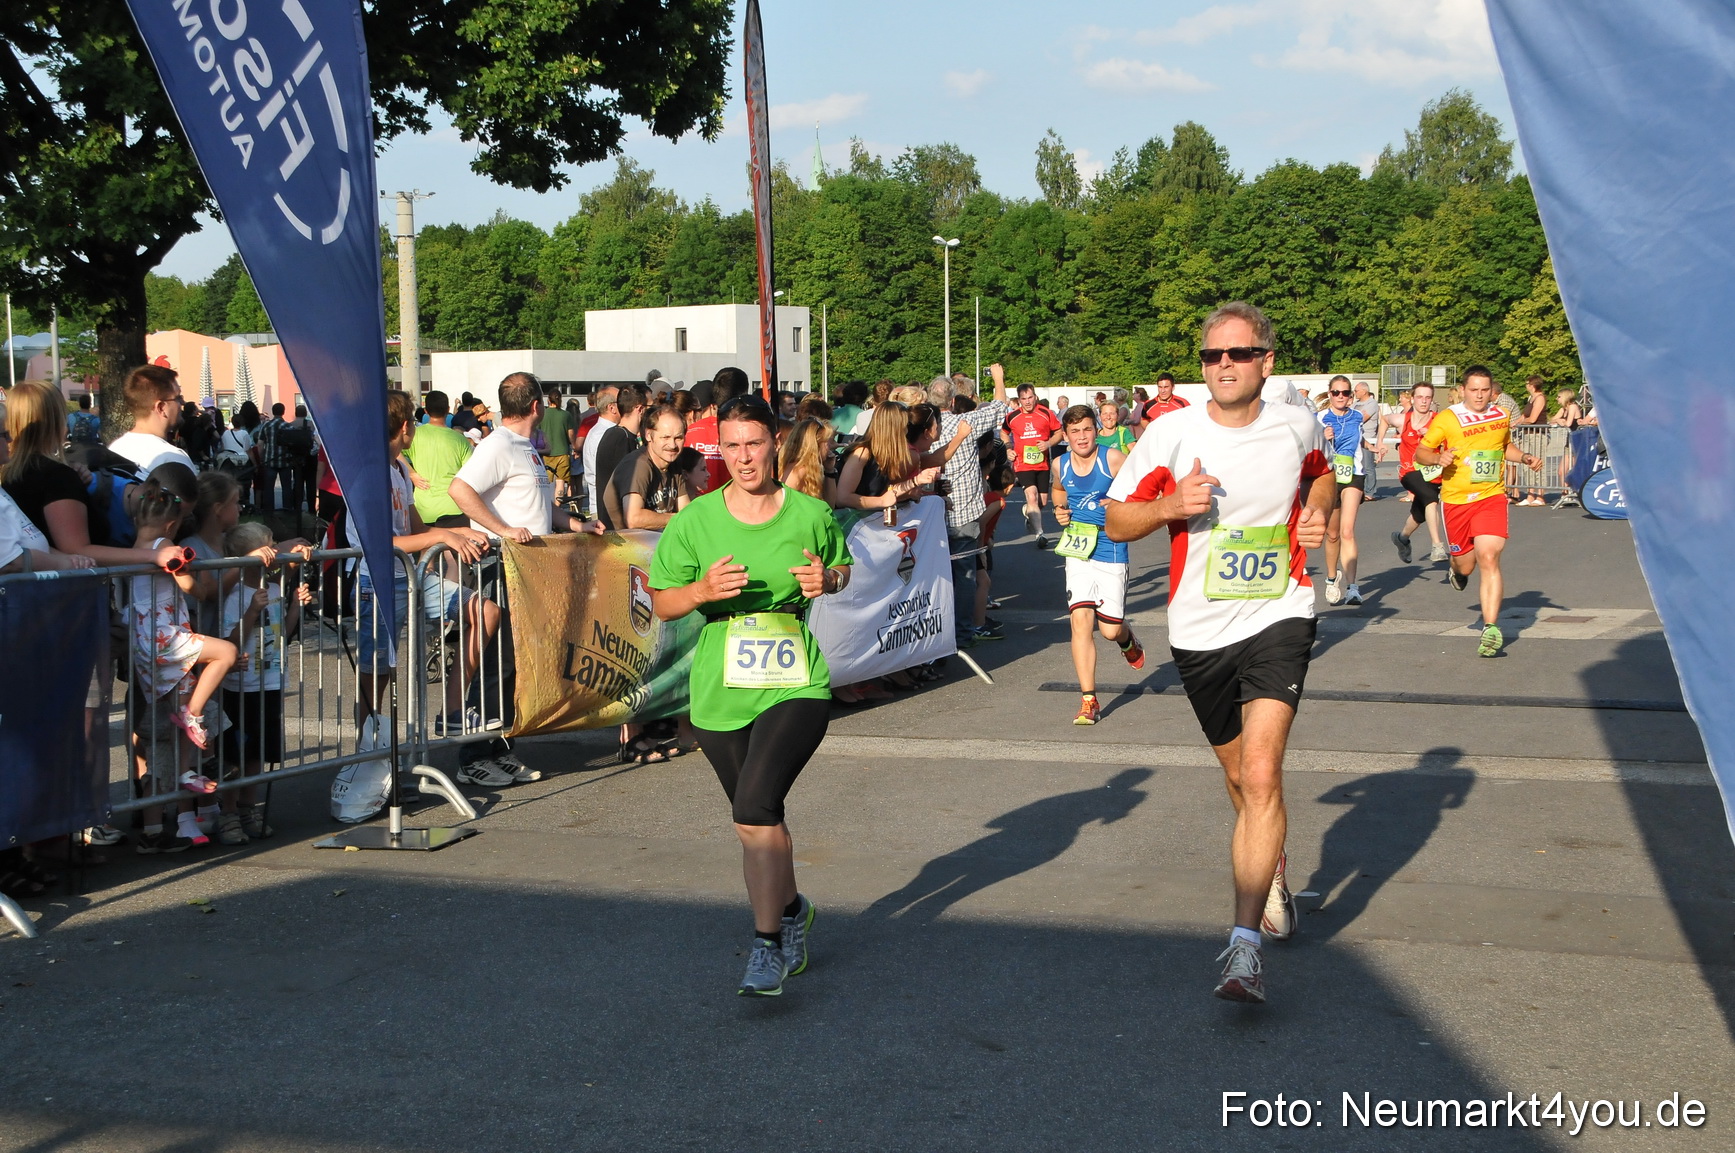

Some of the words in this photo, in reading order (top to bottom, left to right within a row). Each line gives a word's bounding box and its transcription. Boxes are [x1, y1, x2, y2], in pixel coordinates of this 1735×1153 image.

[1463, 426, 1487, 437] MAX
[1026, 452, 1041, 460] 857
[1475, 461, 1496, 475] 831
[1065, 534, 1088, 551] 741
[1218, 551, 1279, 582] 305
[876, 609, 942, 654] Lammsbräu
[736, 639, 796, 669] 576
